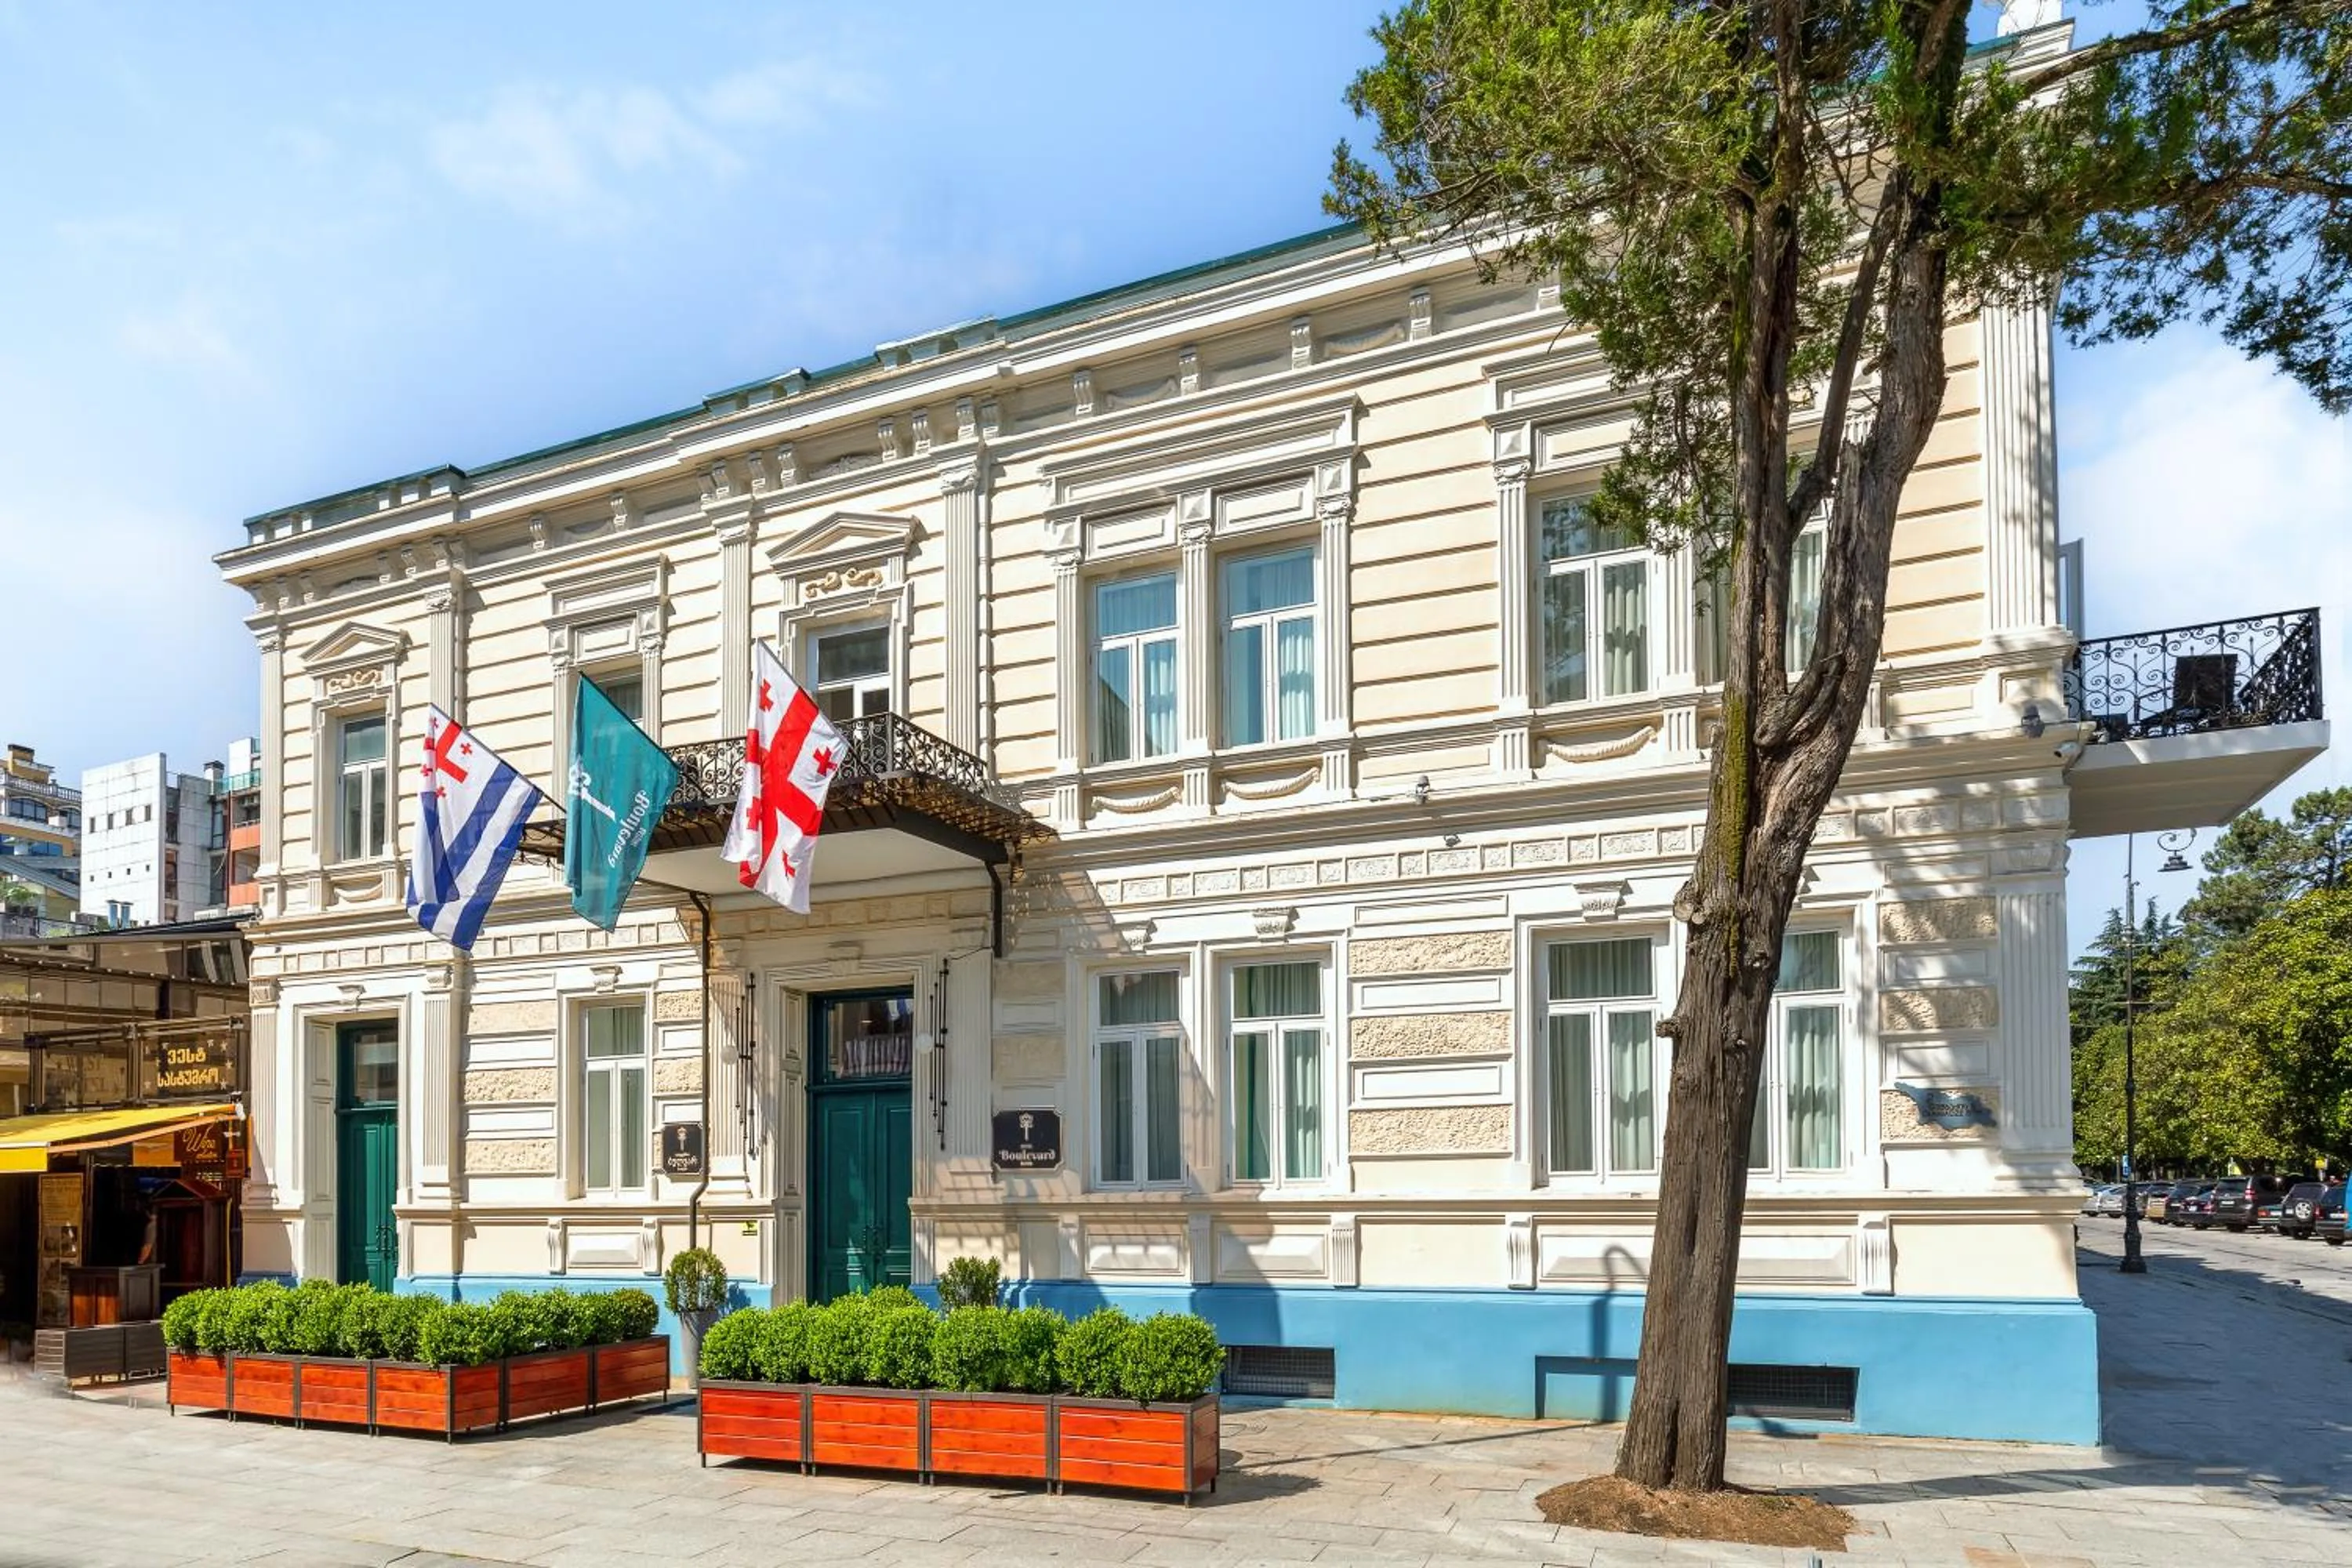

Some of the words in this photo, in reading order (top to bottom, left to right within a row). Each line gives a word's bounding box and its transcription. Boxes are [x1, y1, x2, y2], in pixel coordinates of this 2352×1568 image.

[168, 1047, 207, 1064] ვესტ
[158, 1067, 219, 1087] სასტუმრო
[999, 1149, 1055, 1161] Boulevard
